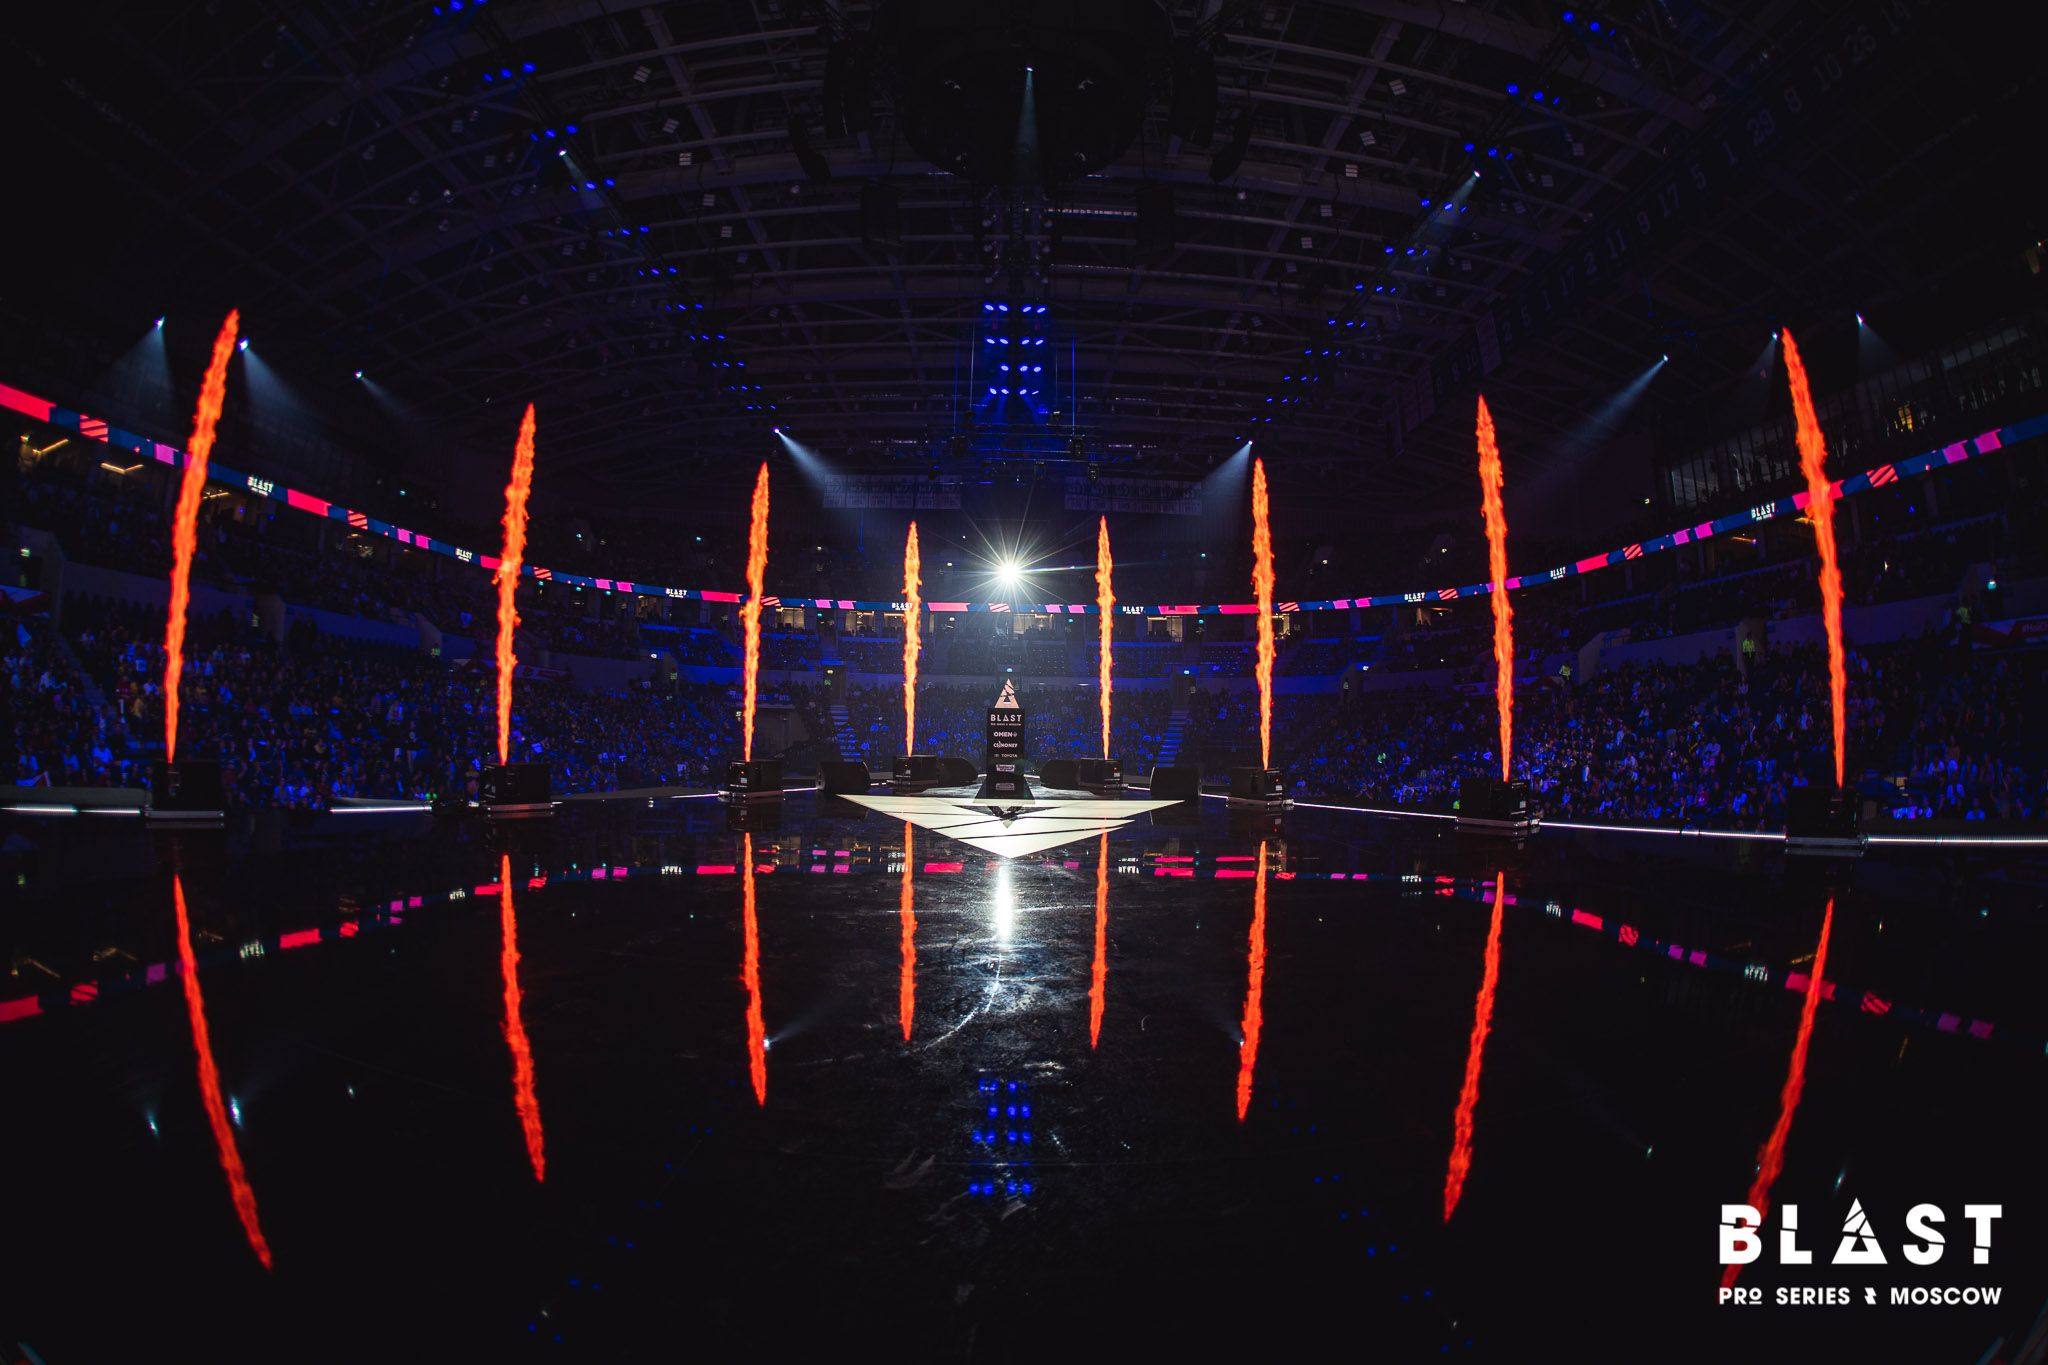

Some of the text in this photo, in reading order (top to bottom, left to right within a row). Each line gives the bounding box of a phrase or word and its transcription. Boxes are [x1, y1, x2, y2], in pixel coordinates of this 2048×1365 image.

[248, 476, 274, 493] BLAST
[1751, 502, 1775, 518] BLAST
[1550, 566, 1566, 578] BLAST
[665, 588, 687, 596] BLAST
[1404, 592, 1425, 600] BLAST
[990, 714, 1022, 722] BLAST
